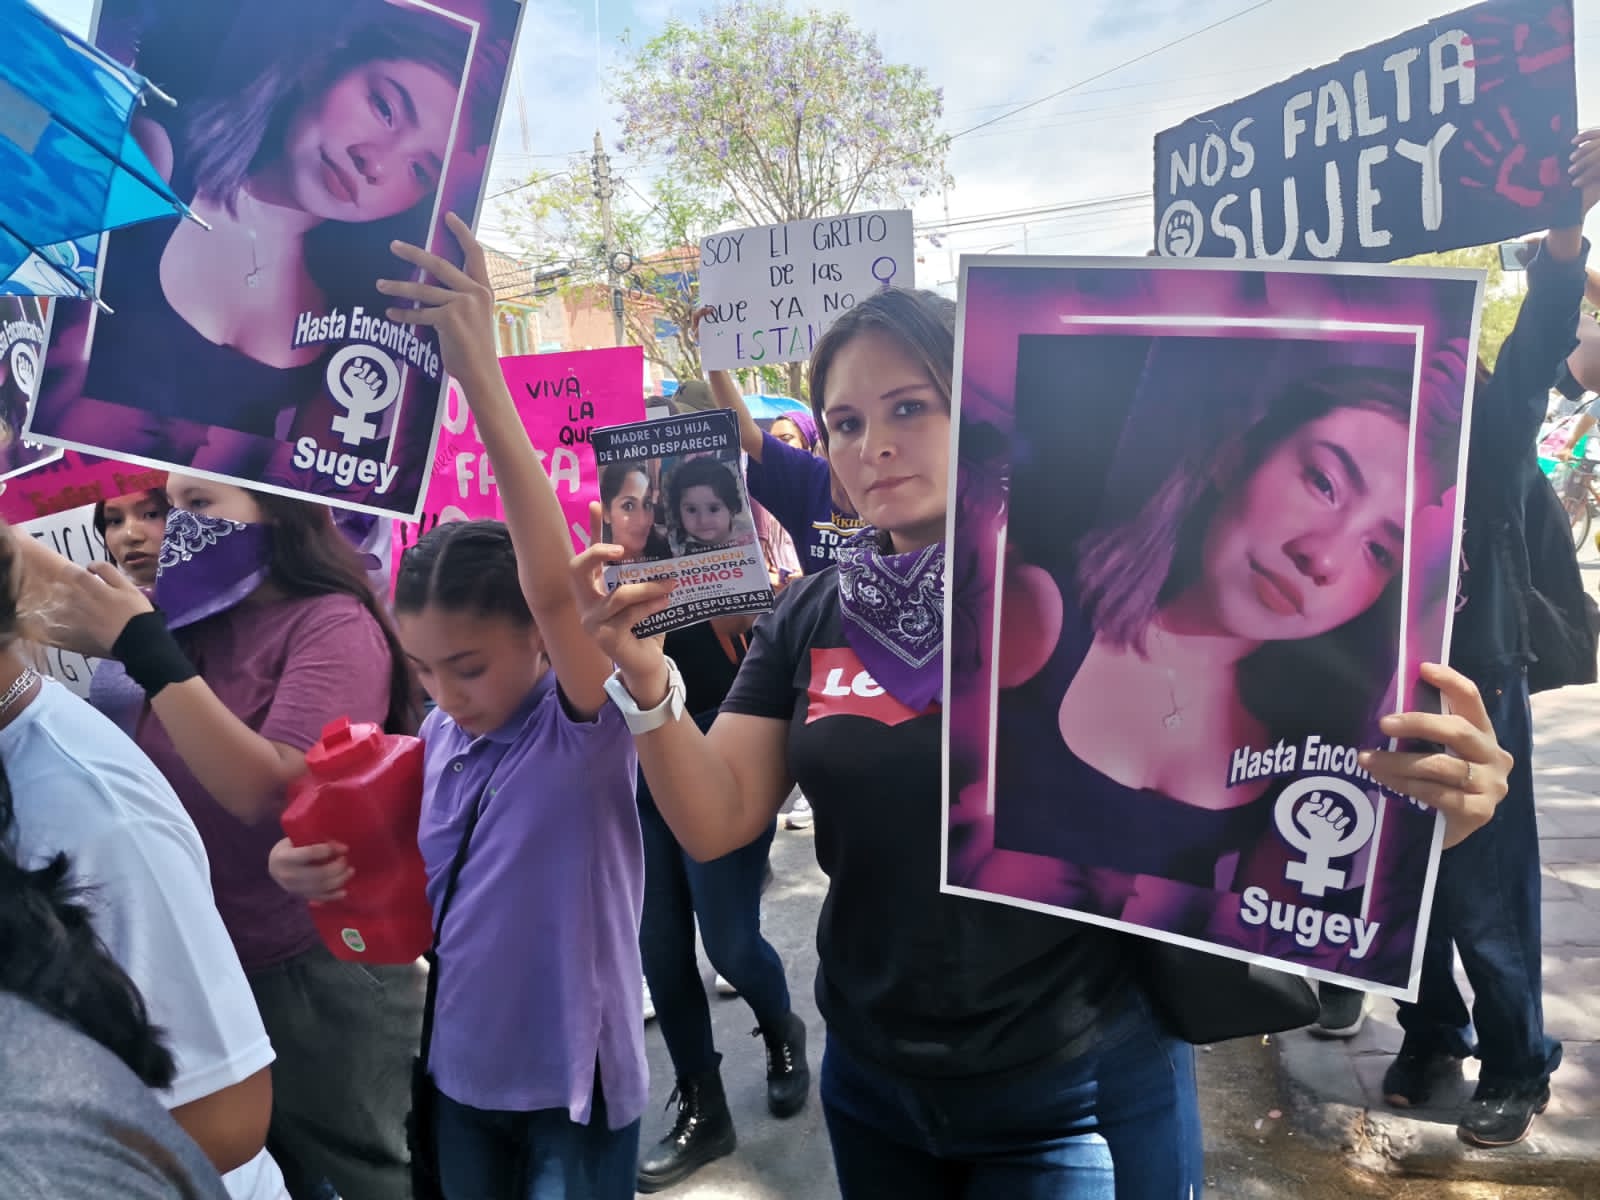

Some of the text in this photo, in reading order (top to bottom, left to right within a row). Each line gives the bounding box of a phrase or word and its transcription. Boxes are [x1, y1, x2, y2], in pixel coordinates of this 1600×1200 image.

[1169, 28, 1476, 196] NOS FALTA
[1210, 122, 1459, 259] SUJEY
[702, 233, 745, 267] SOY
[812, 214, 887, 251] GRITO
[811, 262, 843, 285] las
[769, 296, 804, 320] YA
[824, 291, 855, 313] NO
[295, 306, 439, 378] Hasta Encontrarte
[525, 376, 581, 399] VIVA
[568, 401, 594, 422] LA
[610, 421, 711, 445] MADRE Y SU HIJA
[599, 434, 728, 462] DE 1 AÑO DESPARECEN
[293, 436, 399, 494] Sugey
[456, 447, 580, 499] FAA
[819, 529, 839, 546] TU
[810, 544, 825, 559] ES
[645, 563, 673, 575] NOS
[681, 557, 757, 577] NOSOTRAS
[698, 583, 723, 591] MAYO
[688, 591, 770, 613] RESPUESTAS!
[1230, 738, 1297, 784] Hasta
[1240, 886, 1380, 959] Sugey
